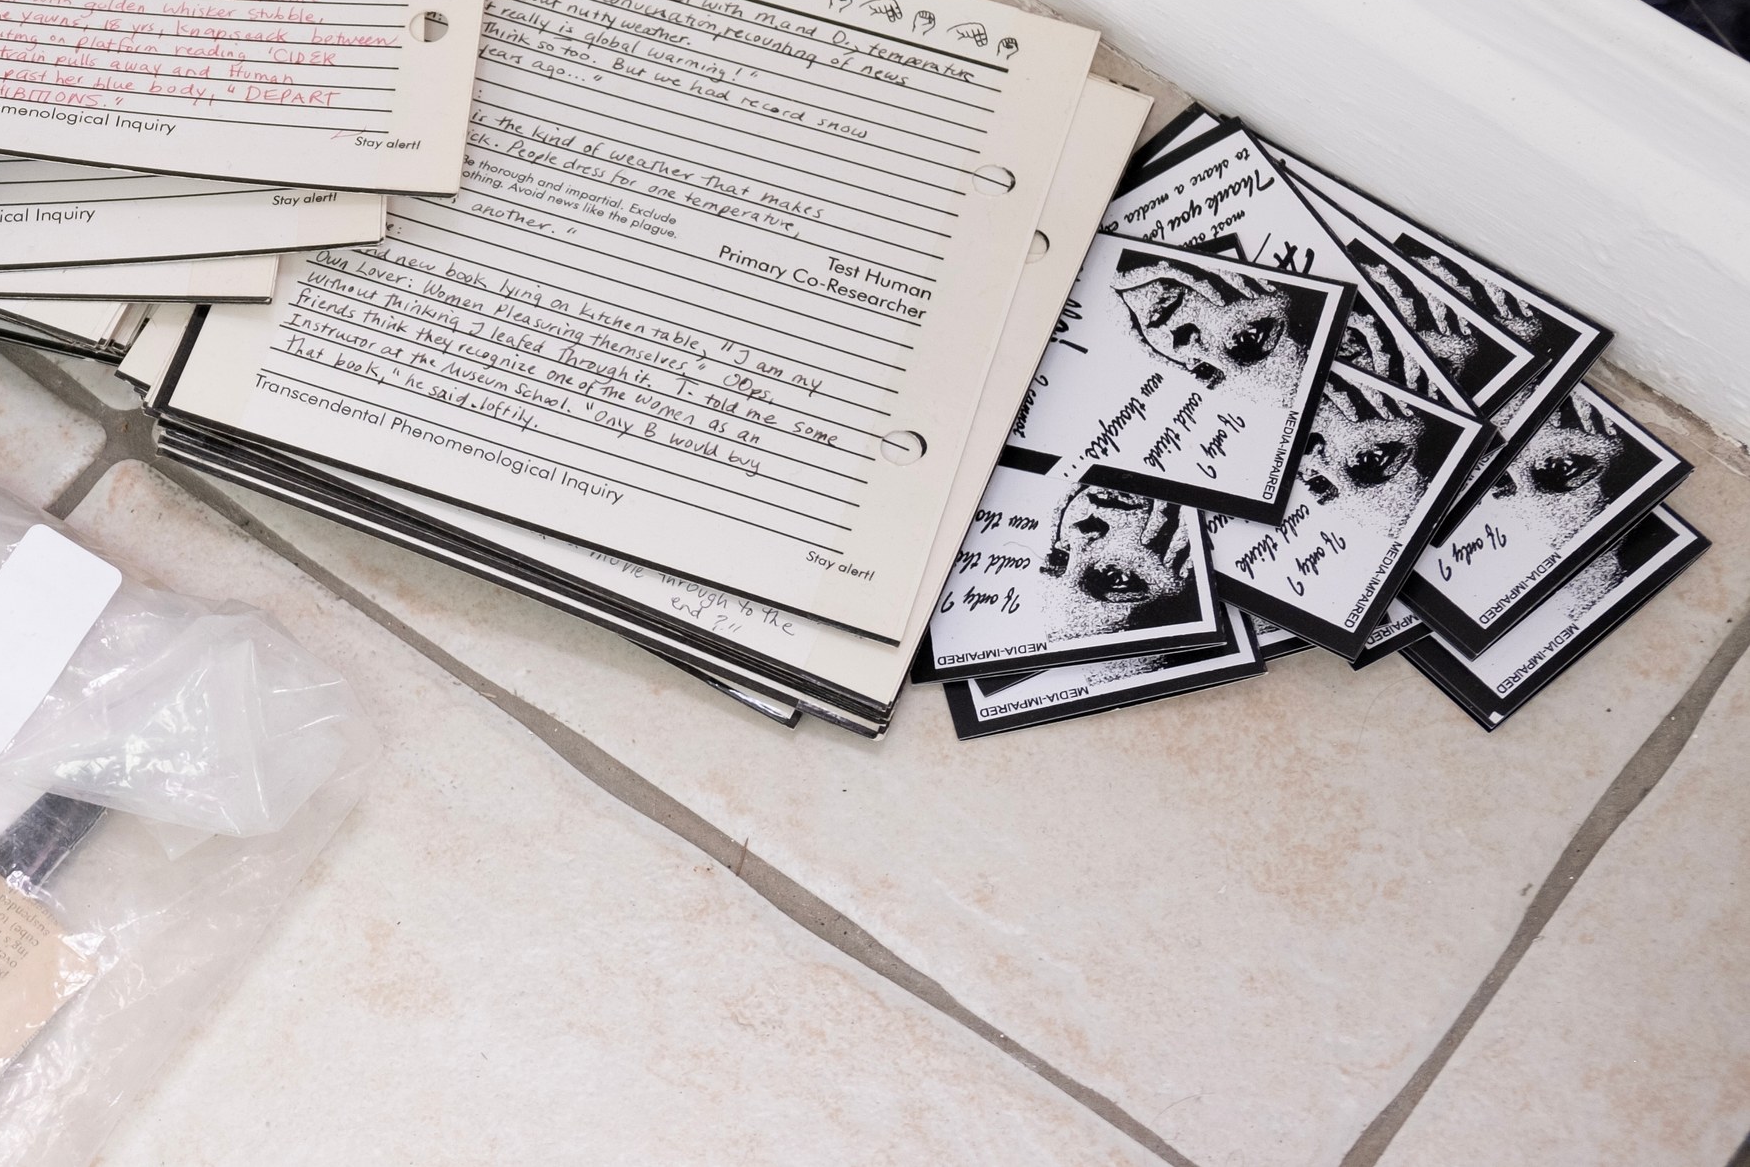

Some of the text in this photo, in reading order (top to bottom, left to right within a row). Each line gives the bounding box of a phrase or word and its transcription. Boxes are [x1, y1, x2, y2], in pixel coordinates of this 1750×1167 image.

[115, 115, 176, 135] Inquiry
[355, 136, 421, 150] Stay alert!
[532, 124, 576, 148] kind
[583, 136, 604, 155] of
[610, 149, 693, 181] weather
[761, 192, 824, 220] makes
[1124, 148, 1250, 224] to share a media
[272, 192, 337, 206] Stay alert!
[463, 170, 678, 241] othing. Avoid news like the plague.
[478, 157, 536, 184] thorough
[538, 176, 563, 191] and
[565, 186, 624, 211] impartial.
[628, 203, 678, 226] Exclude
[1205, 169, 1275, 216] Thank
[36, 206, 95, 224] Inquiry
[1167, 199, 1202, 231] you
[314, 249, 348, 270] Own
[423, 278, 485, 312] Women
[718, 245, 928, 320] Primary Co-Researcher
[827, 256, 933, 301] Test Human
[1141, 373, 1164, 397] new
[254, 373, 625, 505] Transcendental Phenomenological Inquiry
[1143, 392, 1203, 472] could think
[1217, 412, 1246, 435] If
[1200, 428, 1227, 460] only
[1262, 410, 1300, 500] MEDIA-IMPAIRED
[1008, 514, 1039, 531] new
[1276, 503, 1310, 544] could
[1485, 524, 1507, 551] If
[1235, 534, 1279, 580] think
[1320, 531, 1347, 555] If
[1452, 539, 1484, 566] only
[805, 549, 875, 582] Stay alert!
[985, 553, 1031, 575] could
[1295, 546, 1326, 577] only
[963, 586, 999, 611] only
[1001, 587, 1020, 614] If
[1344, 541, 1403, 629] MEDIA-IMPAIRED
[1479, 552, 1562, 625] MEDIA-IMPAIRED
[937, 641, 1048, 666] MEDIA-IMPAIRED
[1496, 623, 1580, 694] MEDIA-IMPAIRED
[980, 686, 1090, 718] MEDIA-IMPAIRED
